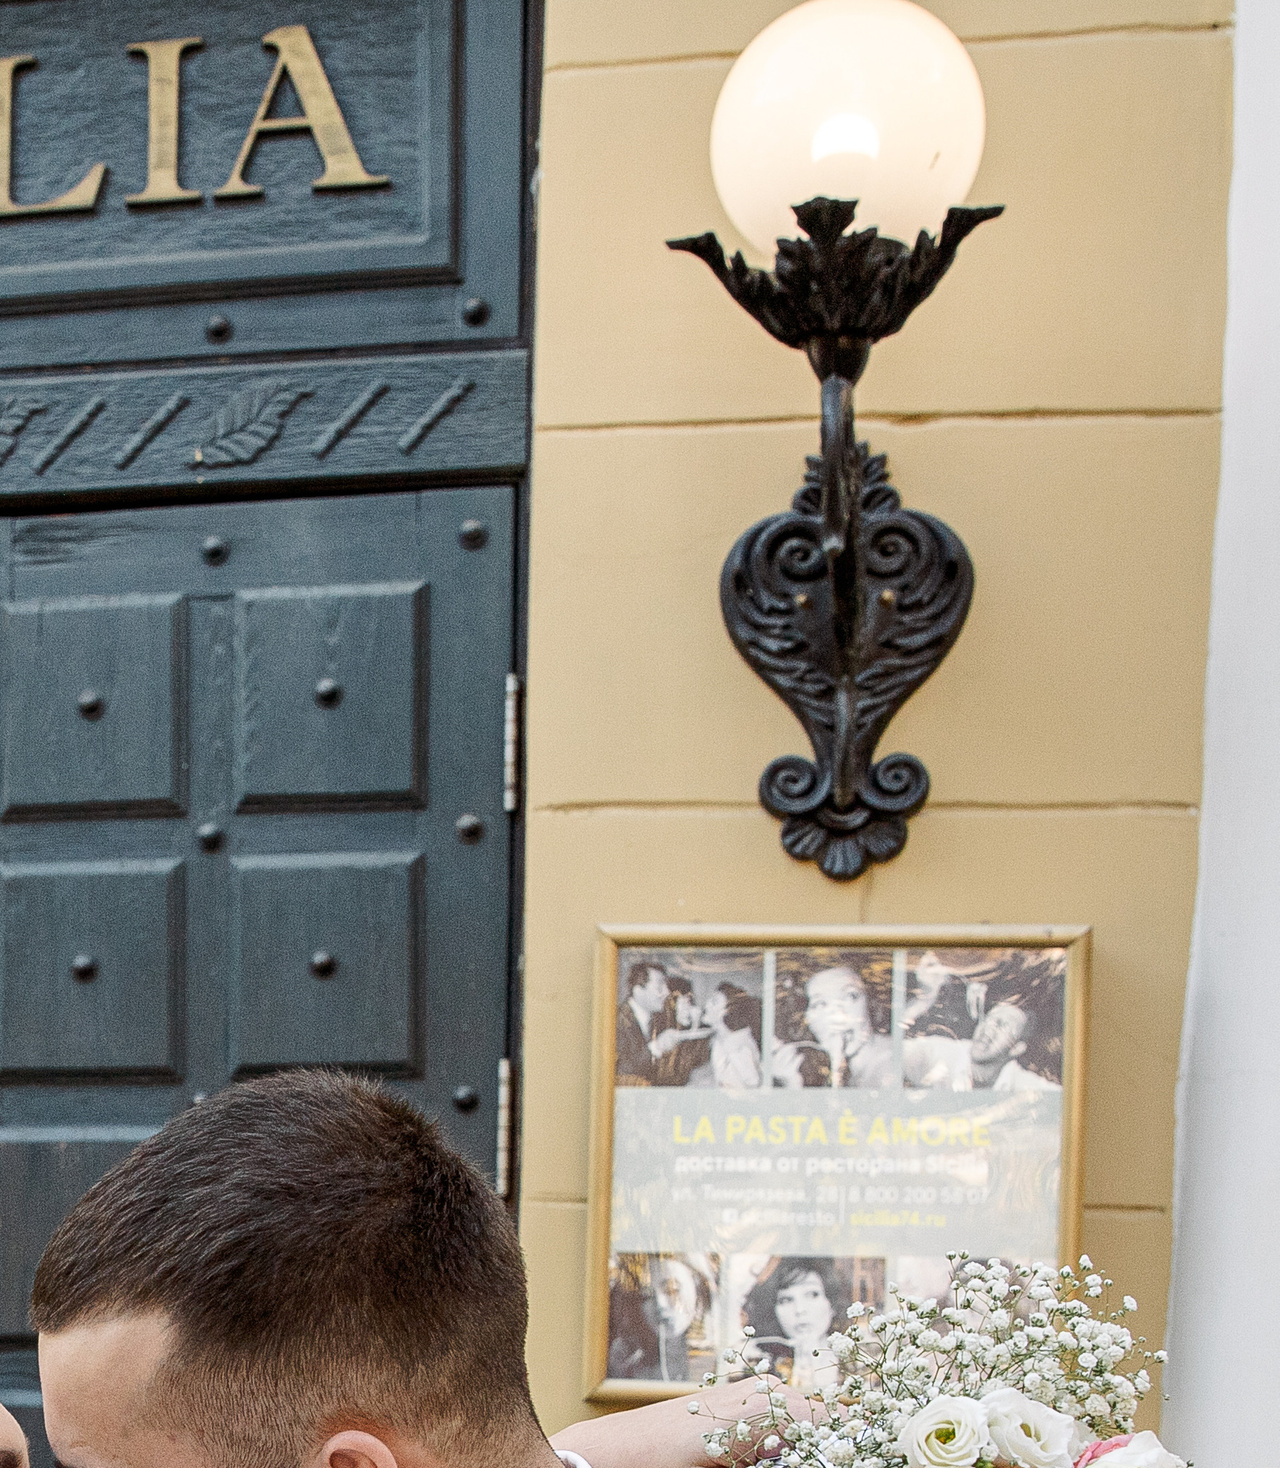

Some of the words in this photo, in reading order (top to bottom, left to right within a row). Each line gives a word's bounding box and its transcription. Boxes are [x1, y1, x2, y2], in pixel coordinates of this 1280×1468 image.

[673, 1114, 716, 1145] LA
[725, 1114, 829, 1146] PASTA
[838, 1109, 859, 1146] È
[866, 1115, 992, 1148] AMORE
[674, 1155, 772, 1175] доставка
[777, 1156, 801, 1173] от
[806, 1156, 920, 1179] ресторана
[864, 1185, 899, 1204] 800
[903, 1186, 937, 1205] 200
